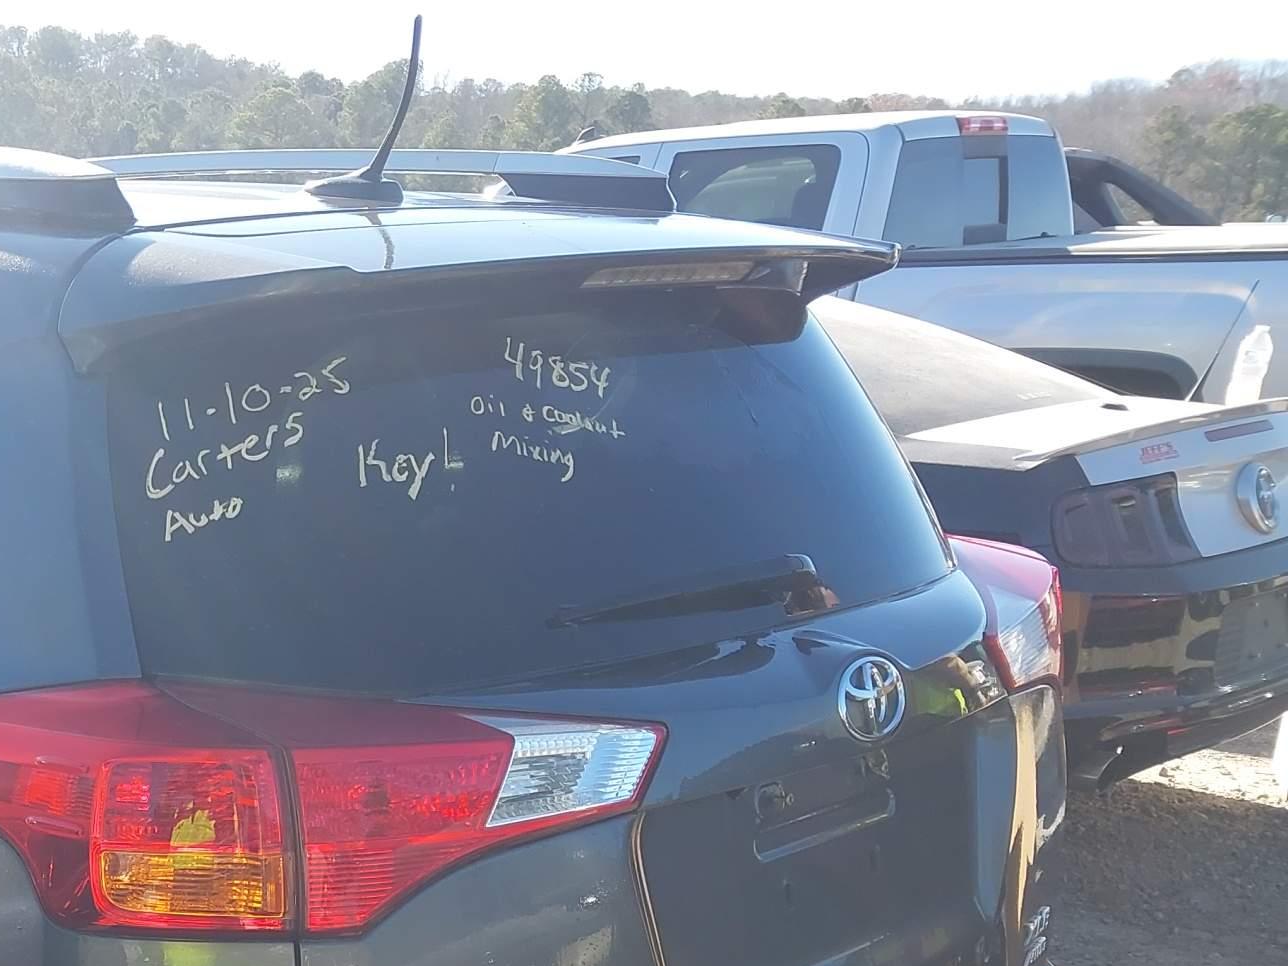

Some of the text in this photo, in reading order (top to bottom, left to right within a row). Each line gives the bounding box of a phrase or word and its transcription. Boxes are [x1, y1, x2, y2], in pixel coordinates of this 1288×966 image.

[505, 337, 611, 398] 49854
[470, 395, 505, 416] Oil
[145, 412, 304, 499] Carters
[492, 430, 574, 482] Mixing
[164, 497, 243, 541] Auto
